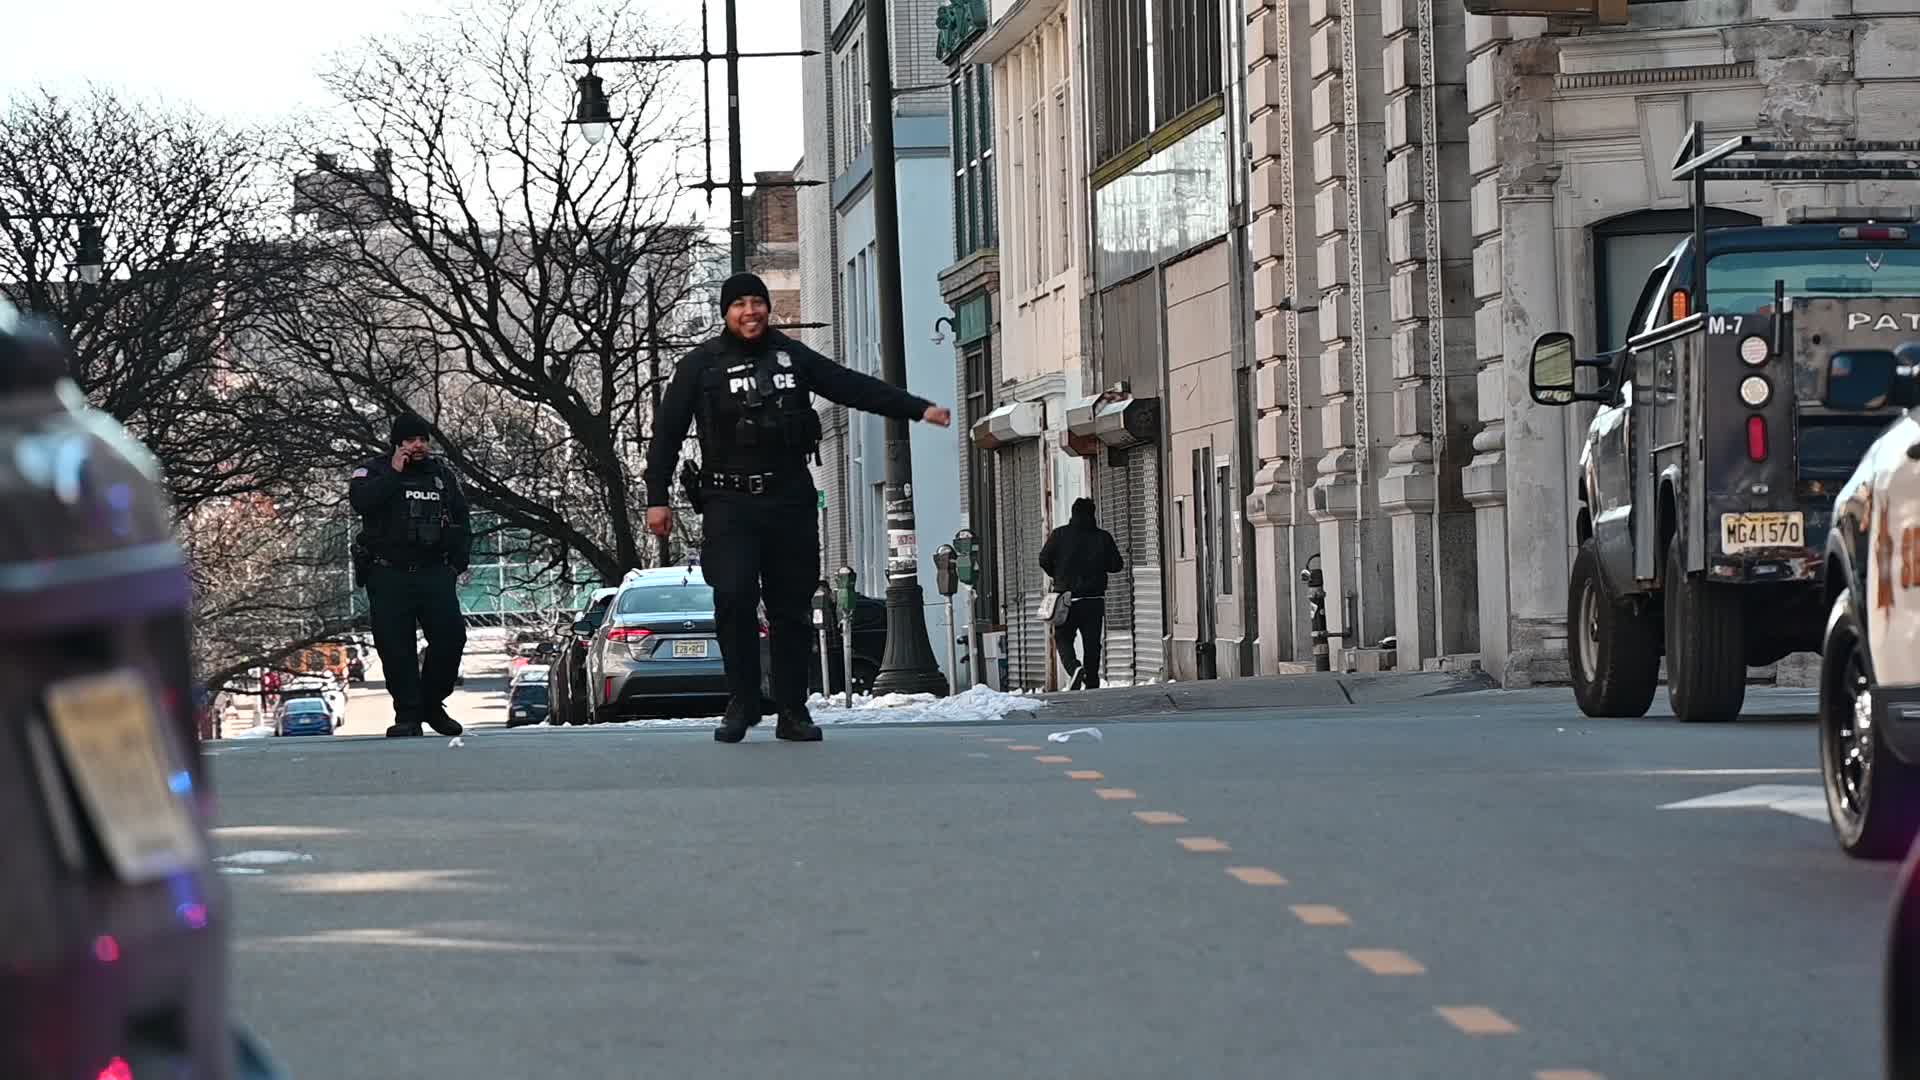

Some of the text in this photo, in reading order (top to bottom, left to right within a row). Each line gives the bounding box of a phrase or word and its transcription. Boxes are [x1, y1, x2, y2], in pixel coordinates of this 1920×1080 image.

[1708, 316, 1744, 335] M-7
[729, 373, 797, 393] POCE
[1727, 522, 1800, 543] MG41570
